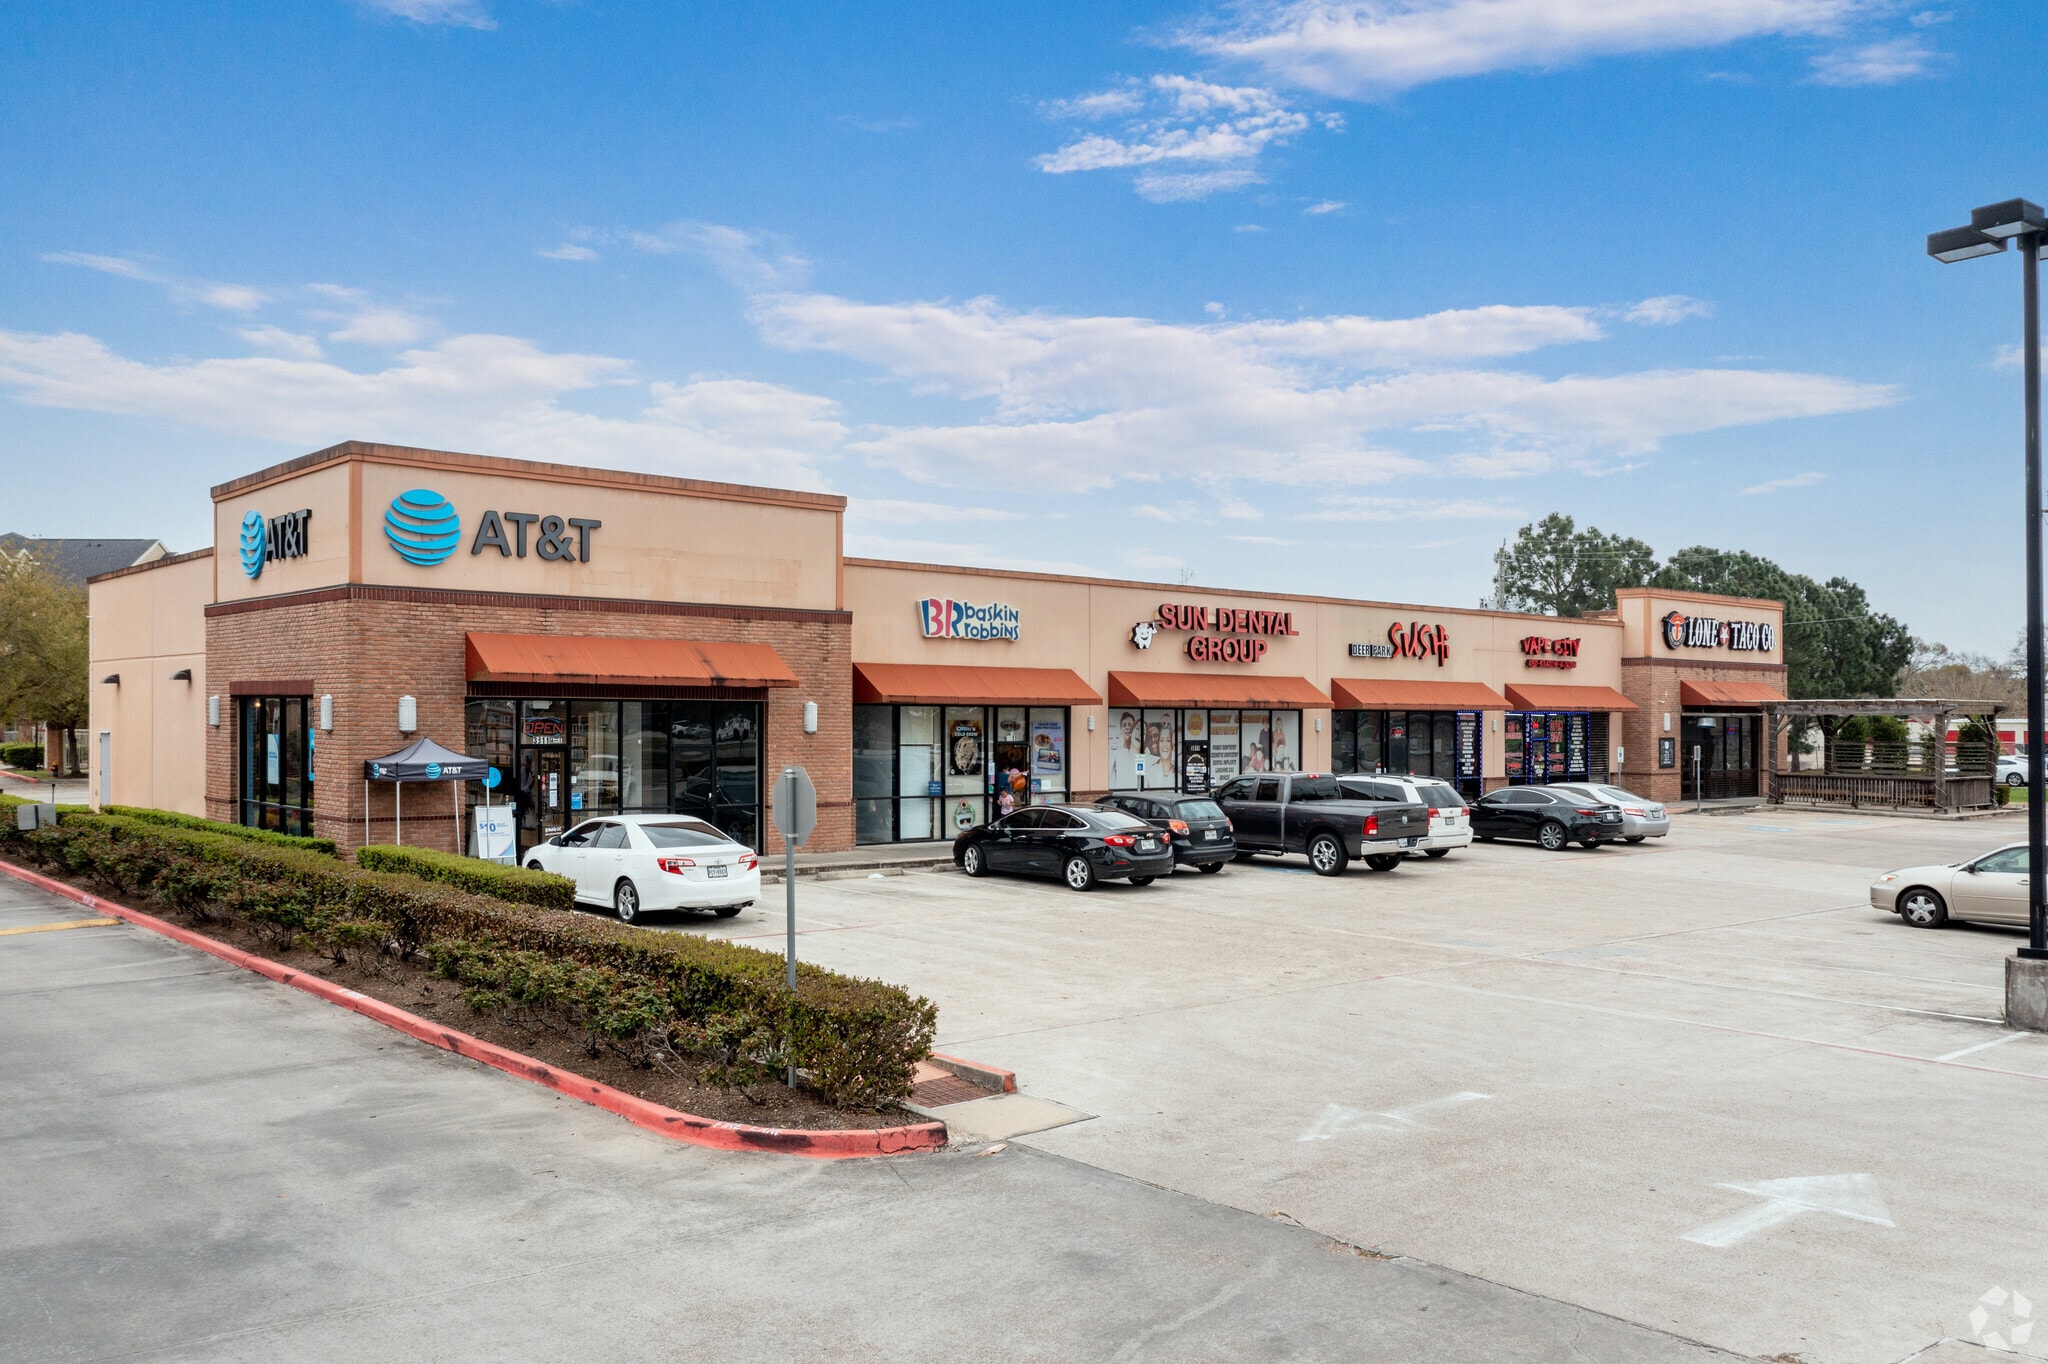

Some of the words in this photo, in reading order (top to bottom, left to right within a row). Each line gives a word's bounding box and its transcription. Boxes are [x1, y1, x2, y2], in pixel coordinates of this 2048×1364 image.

[265, 509, 312, 562] AT&T
[471, 510, 602, 563] AT&T
[964, 602, 1019, 623] baskin
[1158, 603, 1209, 631] SUN
[1216, 607, 1300, 636] DENTAL
[964, 622, 1019, 640] robbins
[1686, 617, 1720, 647] LONE
[1729, 622, 1760, 651] TACO
[1187, 635, 1268, 663] GROUP
[1349, 643, 1371, 657] DEER
[1371, 644, 1392, 658] PARK
[1520, 636, 1552, 655] VAPE
[1551, 637, 1581, 657] CITY
[523, 721, 564, 734] OPEN
[442, 766, 462, 775] AT&T
